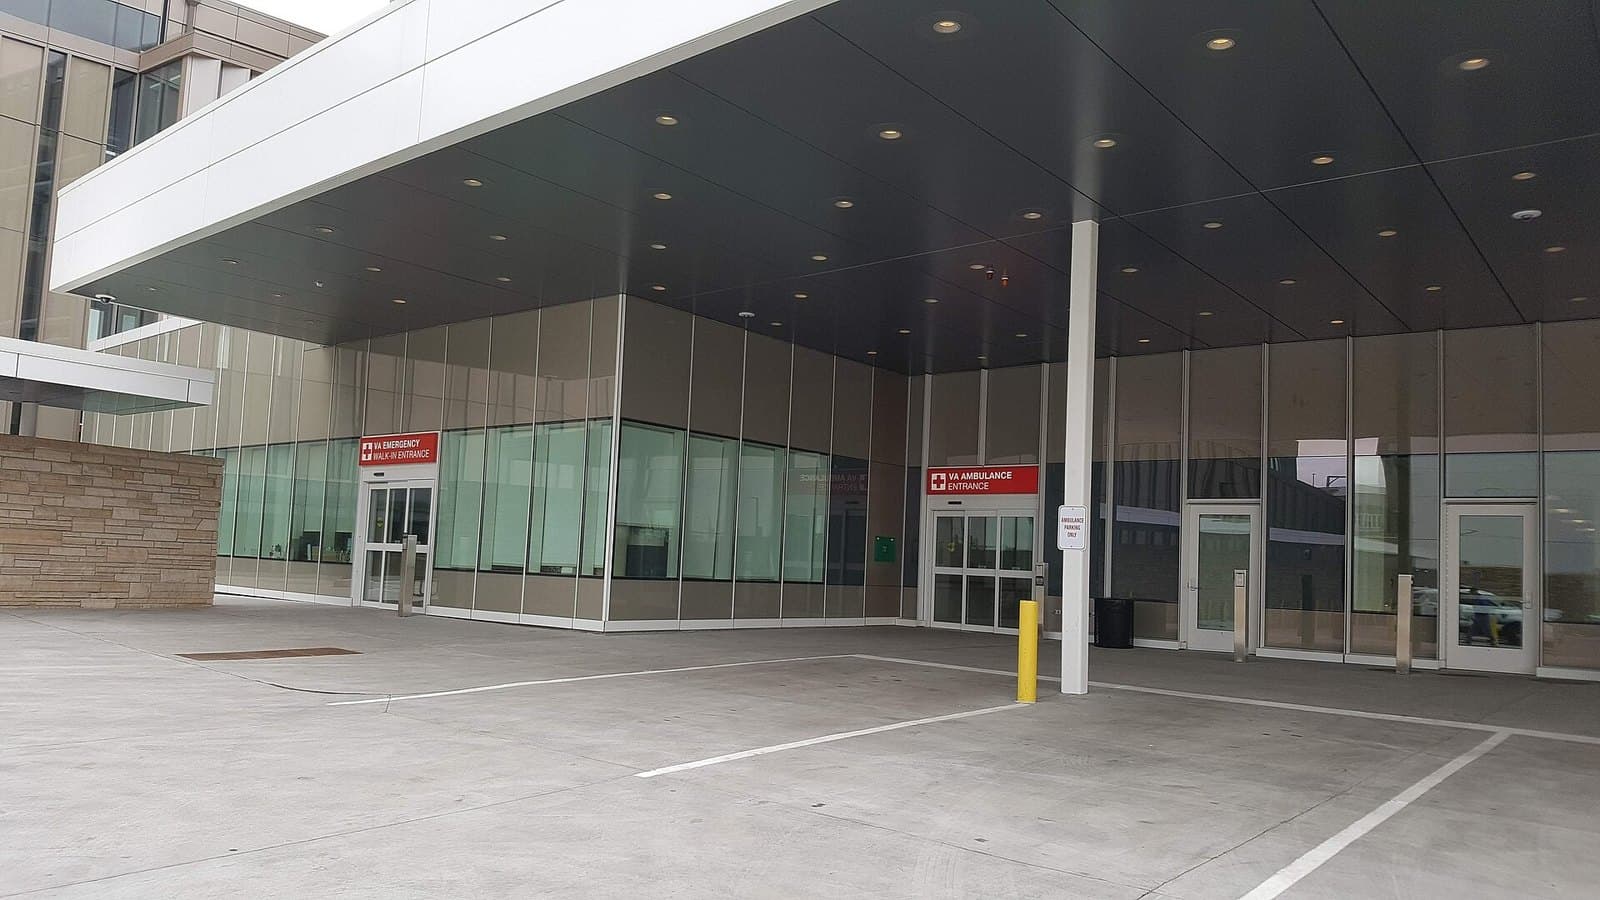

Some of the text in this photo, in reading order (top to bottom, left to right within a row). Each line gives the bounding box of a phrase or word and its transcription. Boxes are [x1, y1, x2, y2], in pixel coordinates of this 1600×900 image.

[374, 440, 420, 450] VA EMERGENCY
[373, 449, 430, 461] WALK-IN ENTRANCE
[960, 471, 1013, 480] AMBULANCE
[948, 482, 989, 490] ENTRANCE
